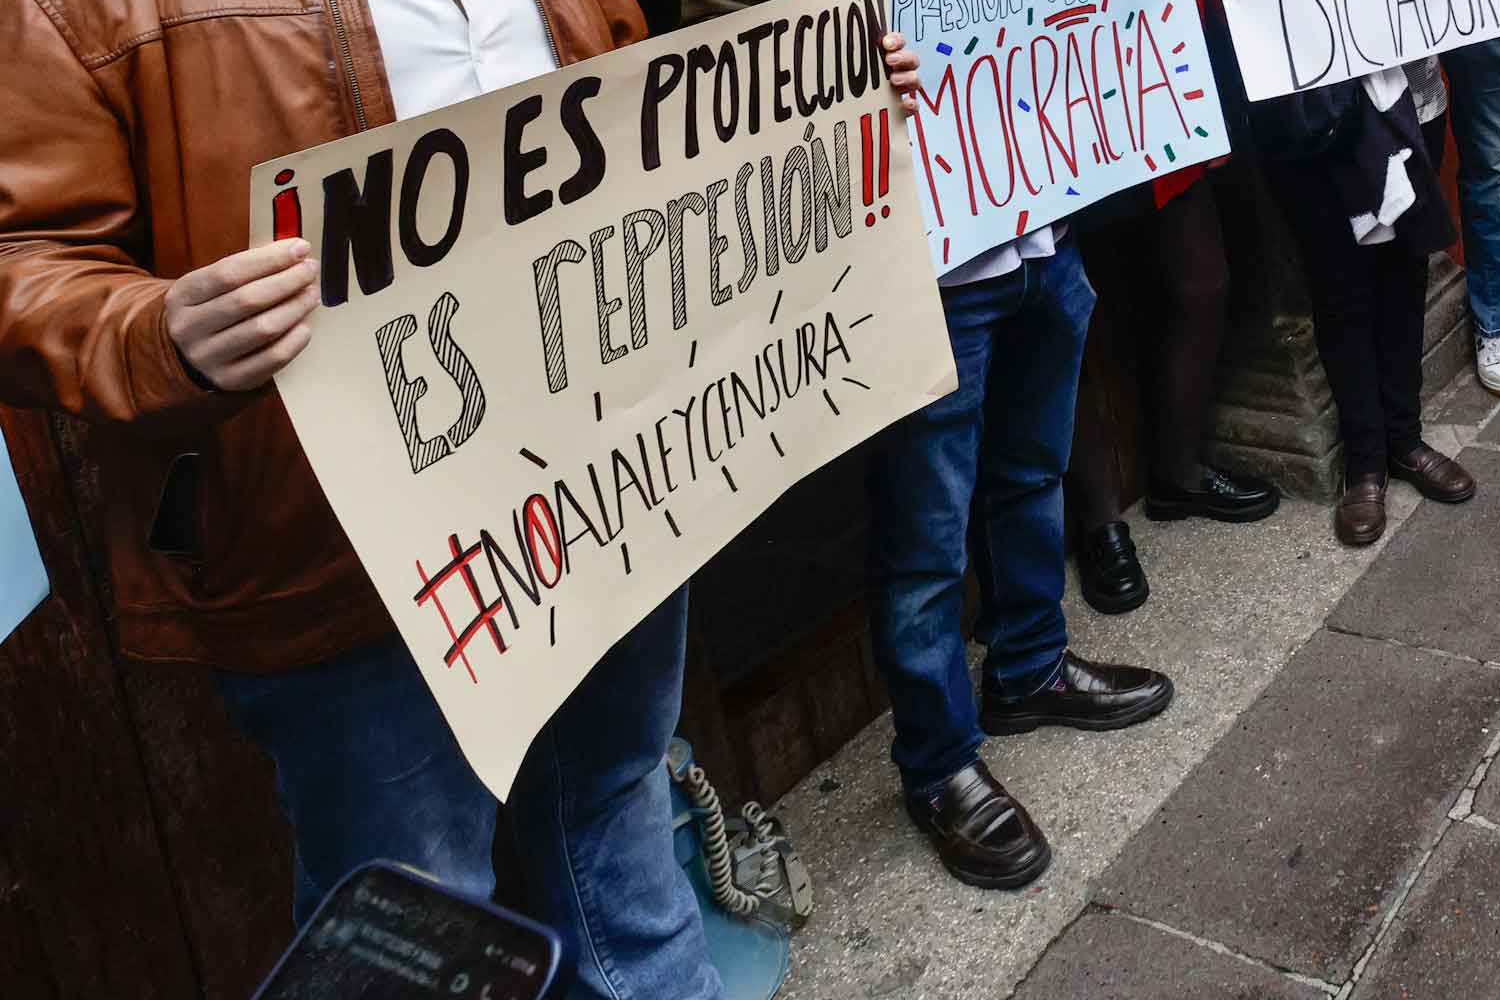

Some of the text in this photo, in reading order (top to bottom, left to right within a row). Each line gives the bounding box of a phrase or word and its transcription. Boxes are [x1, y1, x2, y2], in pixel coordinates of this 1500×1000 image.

[504, 76, 604, 228] ES
[908, 8, 1191, 228] MOCRACIA
[374, 291, 486, 475] ES
[414, 312, 852, 684] #NOALALEYCENSURA
